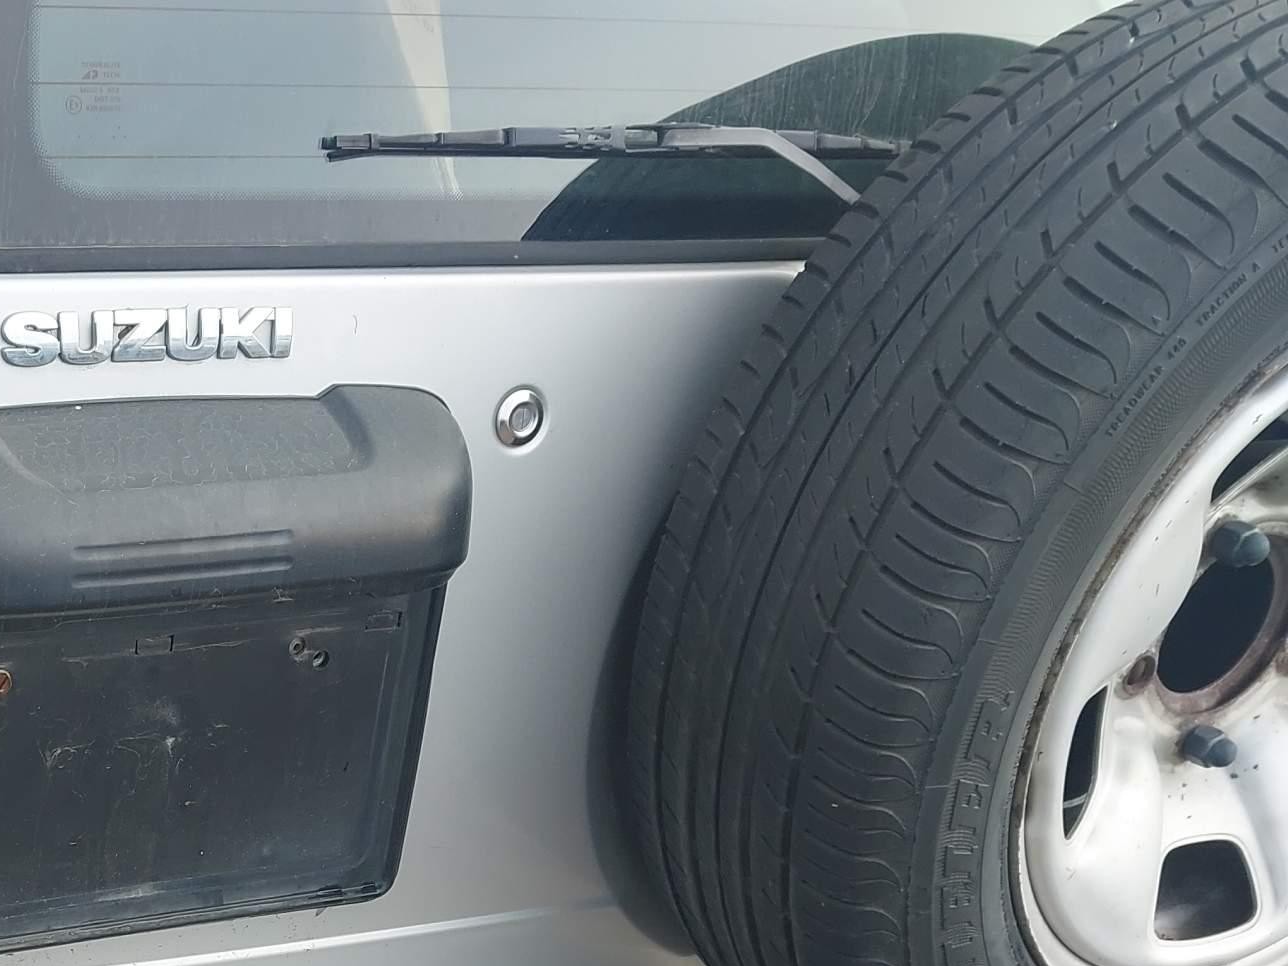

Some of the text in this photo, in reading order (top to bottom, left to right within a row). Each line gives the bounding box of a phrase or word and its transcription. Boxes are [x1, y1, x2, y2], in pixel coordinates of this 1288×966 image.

[0, 305, 294, 368] SUZUKI
[1105, 365, 1163, 436] TREADWEAR
[1196, 273, 1249, 328] TRACTION
